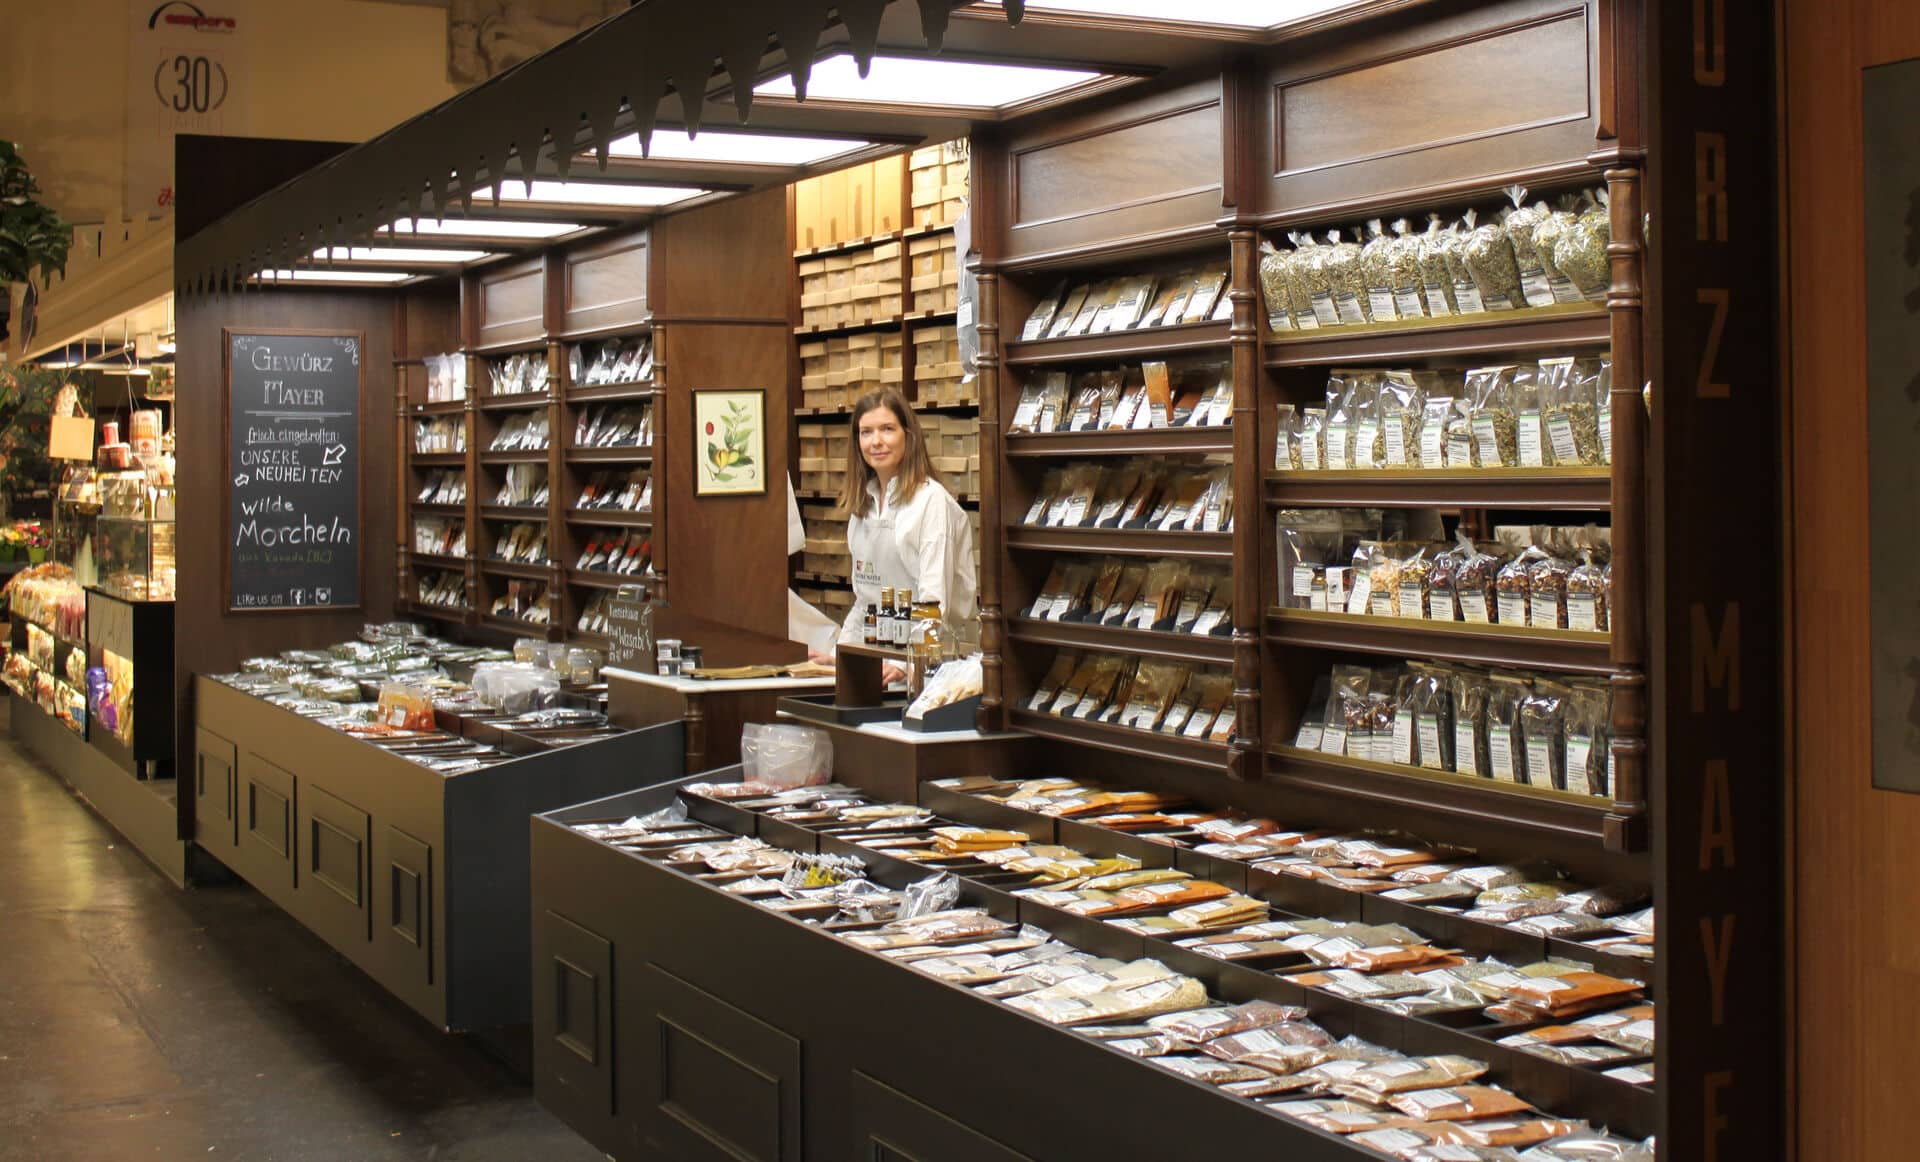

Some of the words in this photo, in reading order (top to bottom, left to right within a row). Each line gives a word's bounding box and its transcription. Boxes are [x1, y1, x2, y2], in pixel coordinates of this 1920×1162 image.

[263, 379, 325, 406] MAYER
[241, 449, 300, 465] UNSERE
[236, 513, 351, 547] Morcheln
